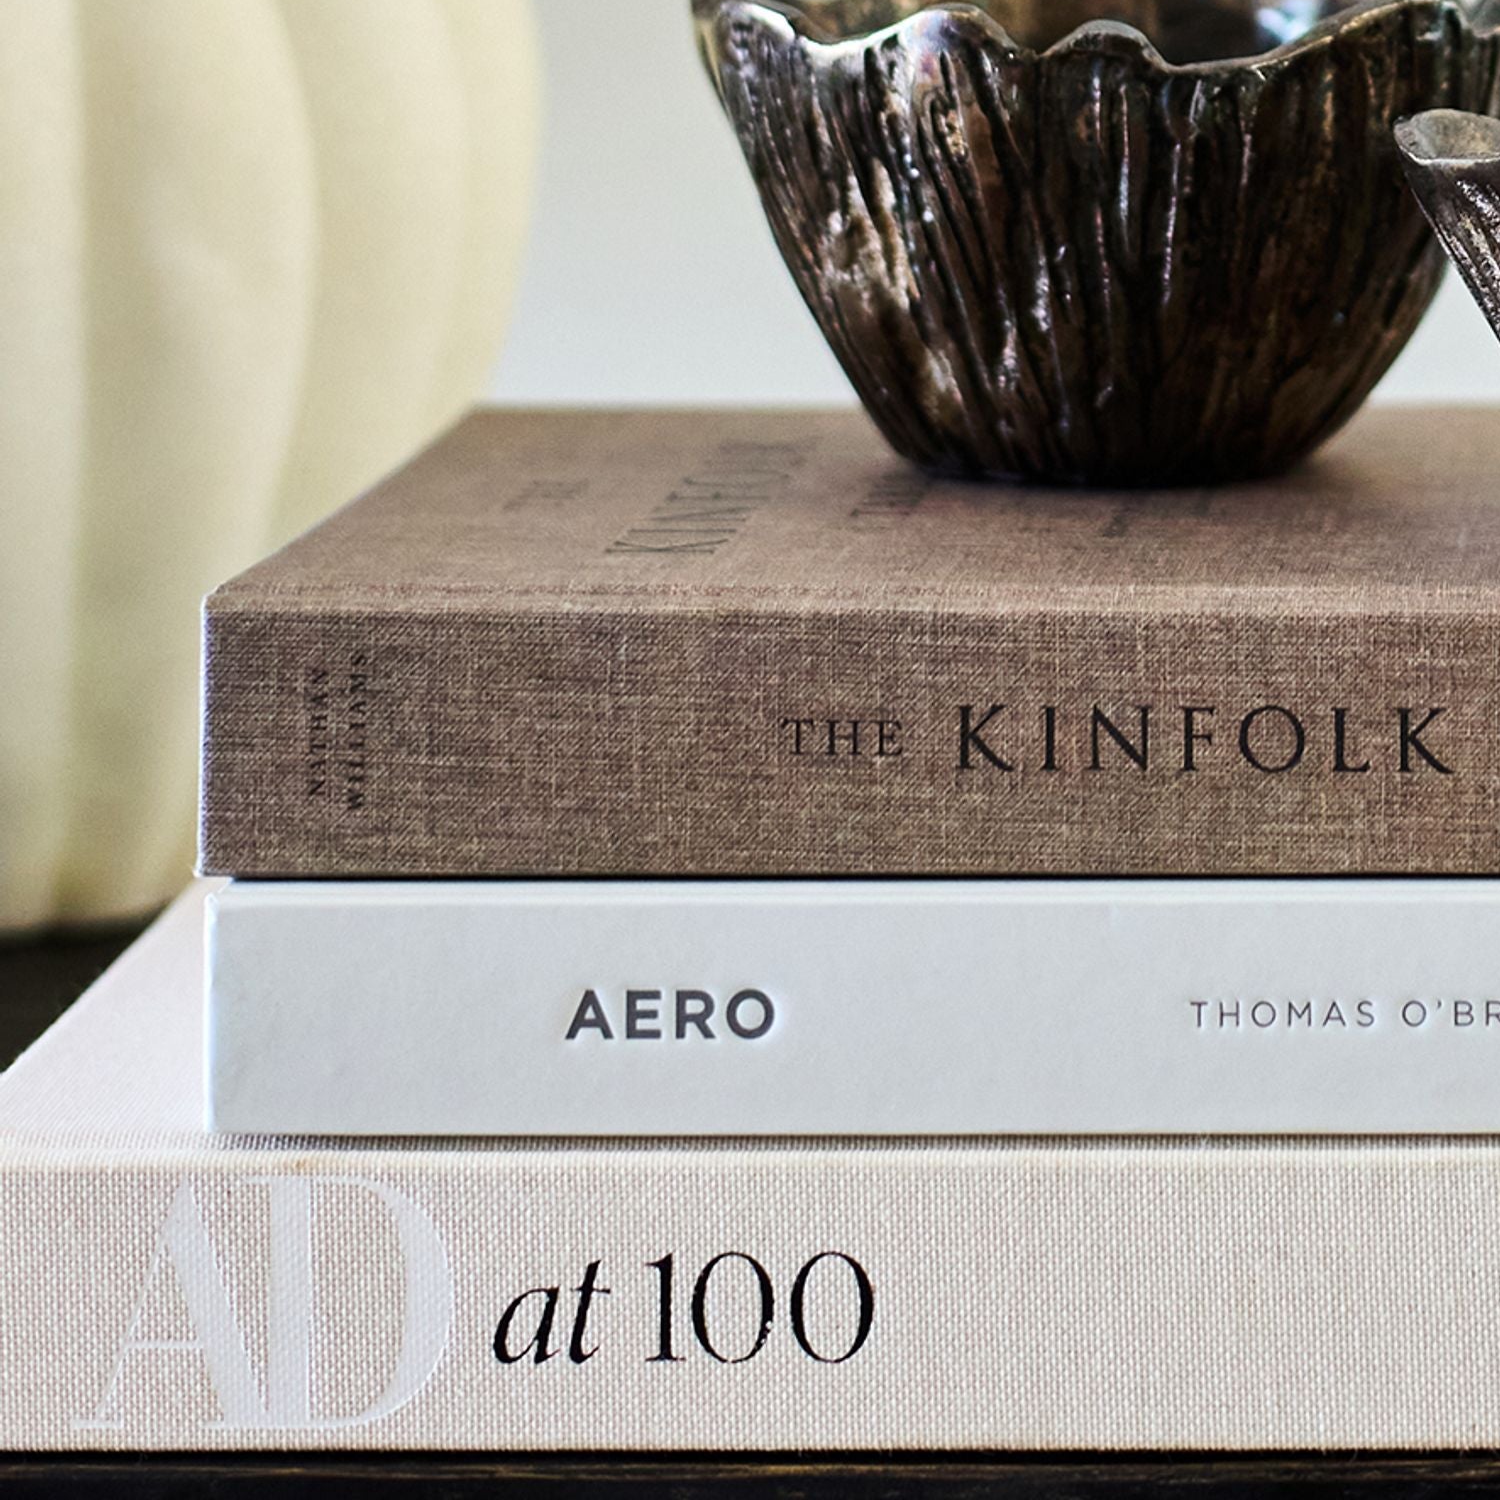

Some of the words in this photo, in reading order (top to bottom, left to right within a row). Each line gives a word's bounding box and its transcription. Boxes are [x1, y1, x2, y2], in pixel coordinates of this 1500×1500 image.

[306, 667, 330, 797] NATHAN
[347, 650, 369, 811] WILLIAMS
[778, 716, 905, 759] THE
[954, 702, 1455, 776] KINFOLK
[563, 987, 776, 1042] AERO
[1188, 998, 1376, 1029] THOMAS
[70, 1174, 455, 1432] AD
[491, 1259, 612, 1366] at
[646, 1250, 876, 1365] 100
